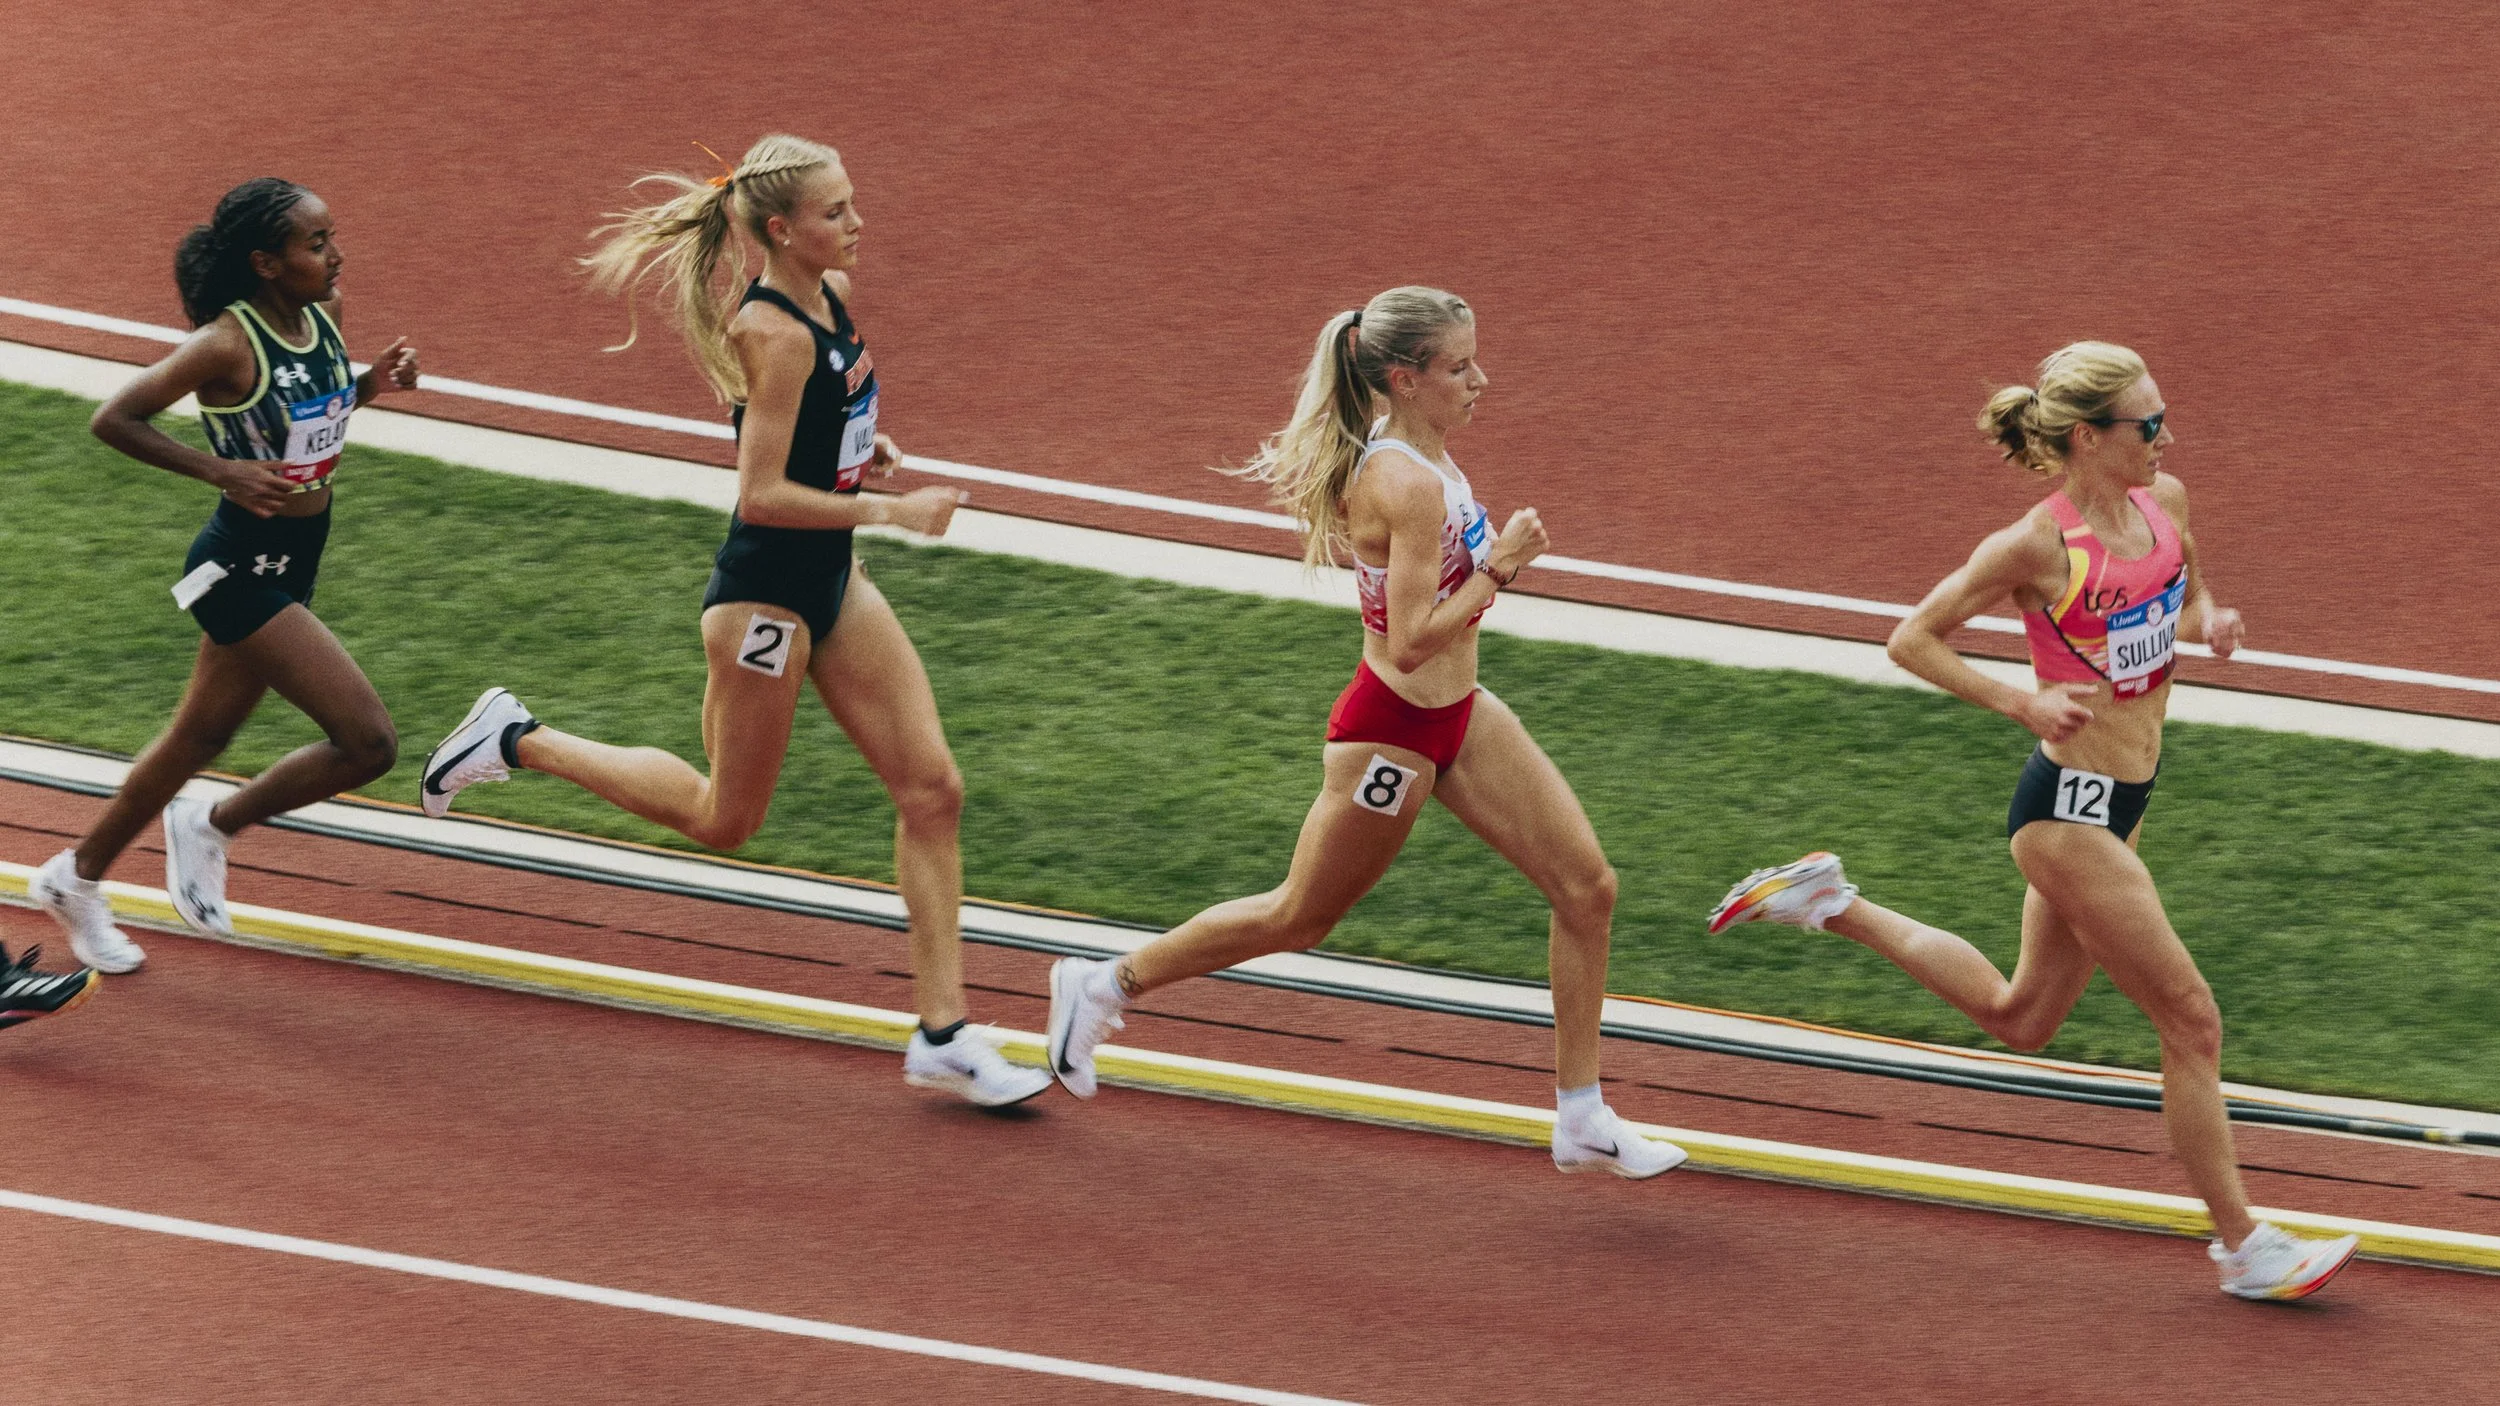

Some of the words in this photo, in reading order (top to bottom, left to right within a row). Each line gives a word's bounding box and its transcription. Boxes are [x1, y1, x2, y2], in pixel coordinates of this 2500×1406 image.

[742, 624, 783, 670] 2
[1363, 766, 1403, 808] 8
[2062, 776, 2105, 819] 12
